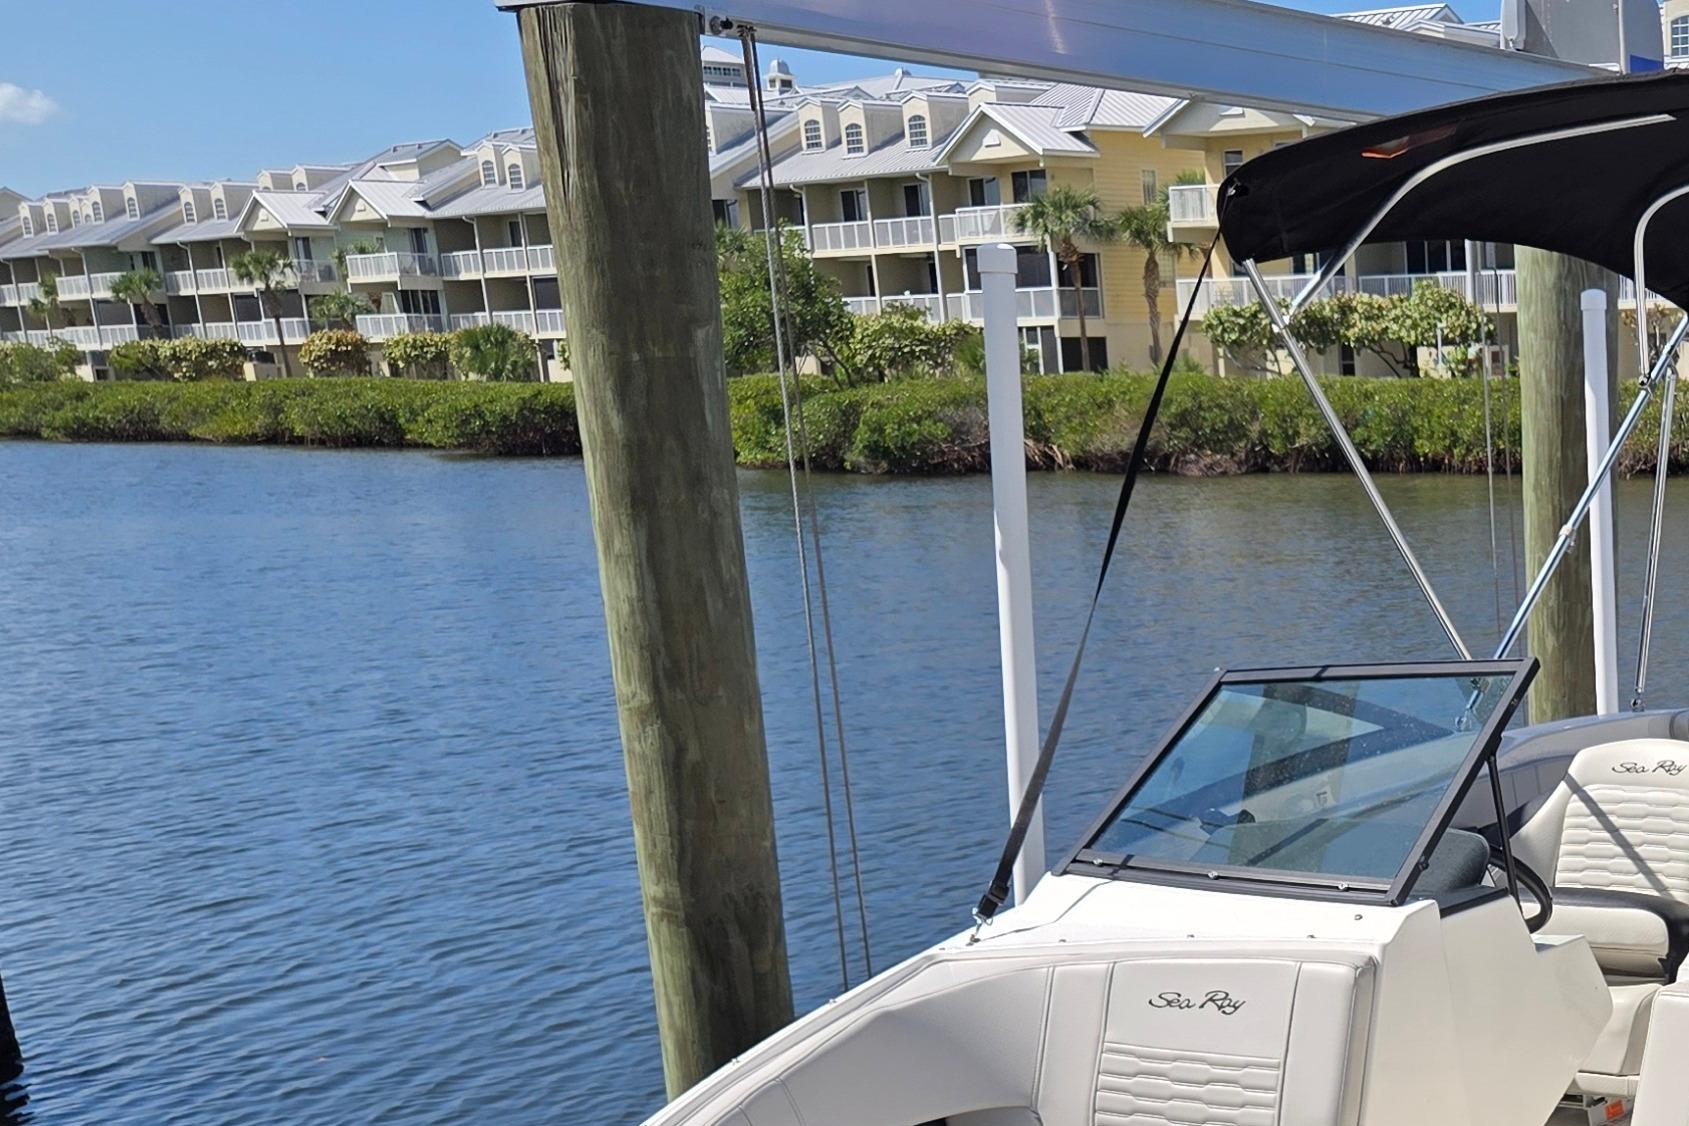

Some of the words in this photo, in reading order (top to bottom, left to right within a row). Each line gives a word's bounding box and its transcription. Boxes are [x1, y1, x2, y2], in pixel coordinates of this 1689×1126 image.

[1611, 761, 1650, 774] Sea
[1652, 759, 1688, 776] Ray
[1148, 991, 1197, 1010] Sea
[1199, 989, 1247, 1016] Ray
